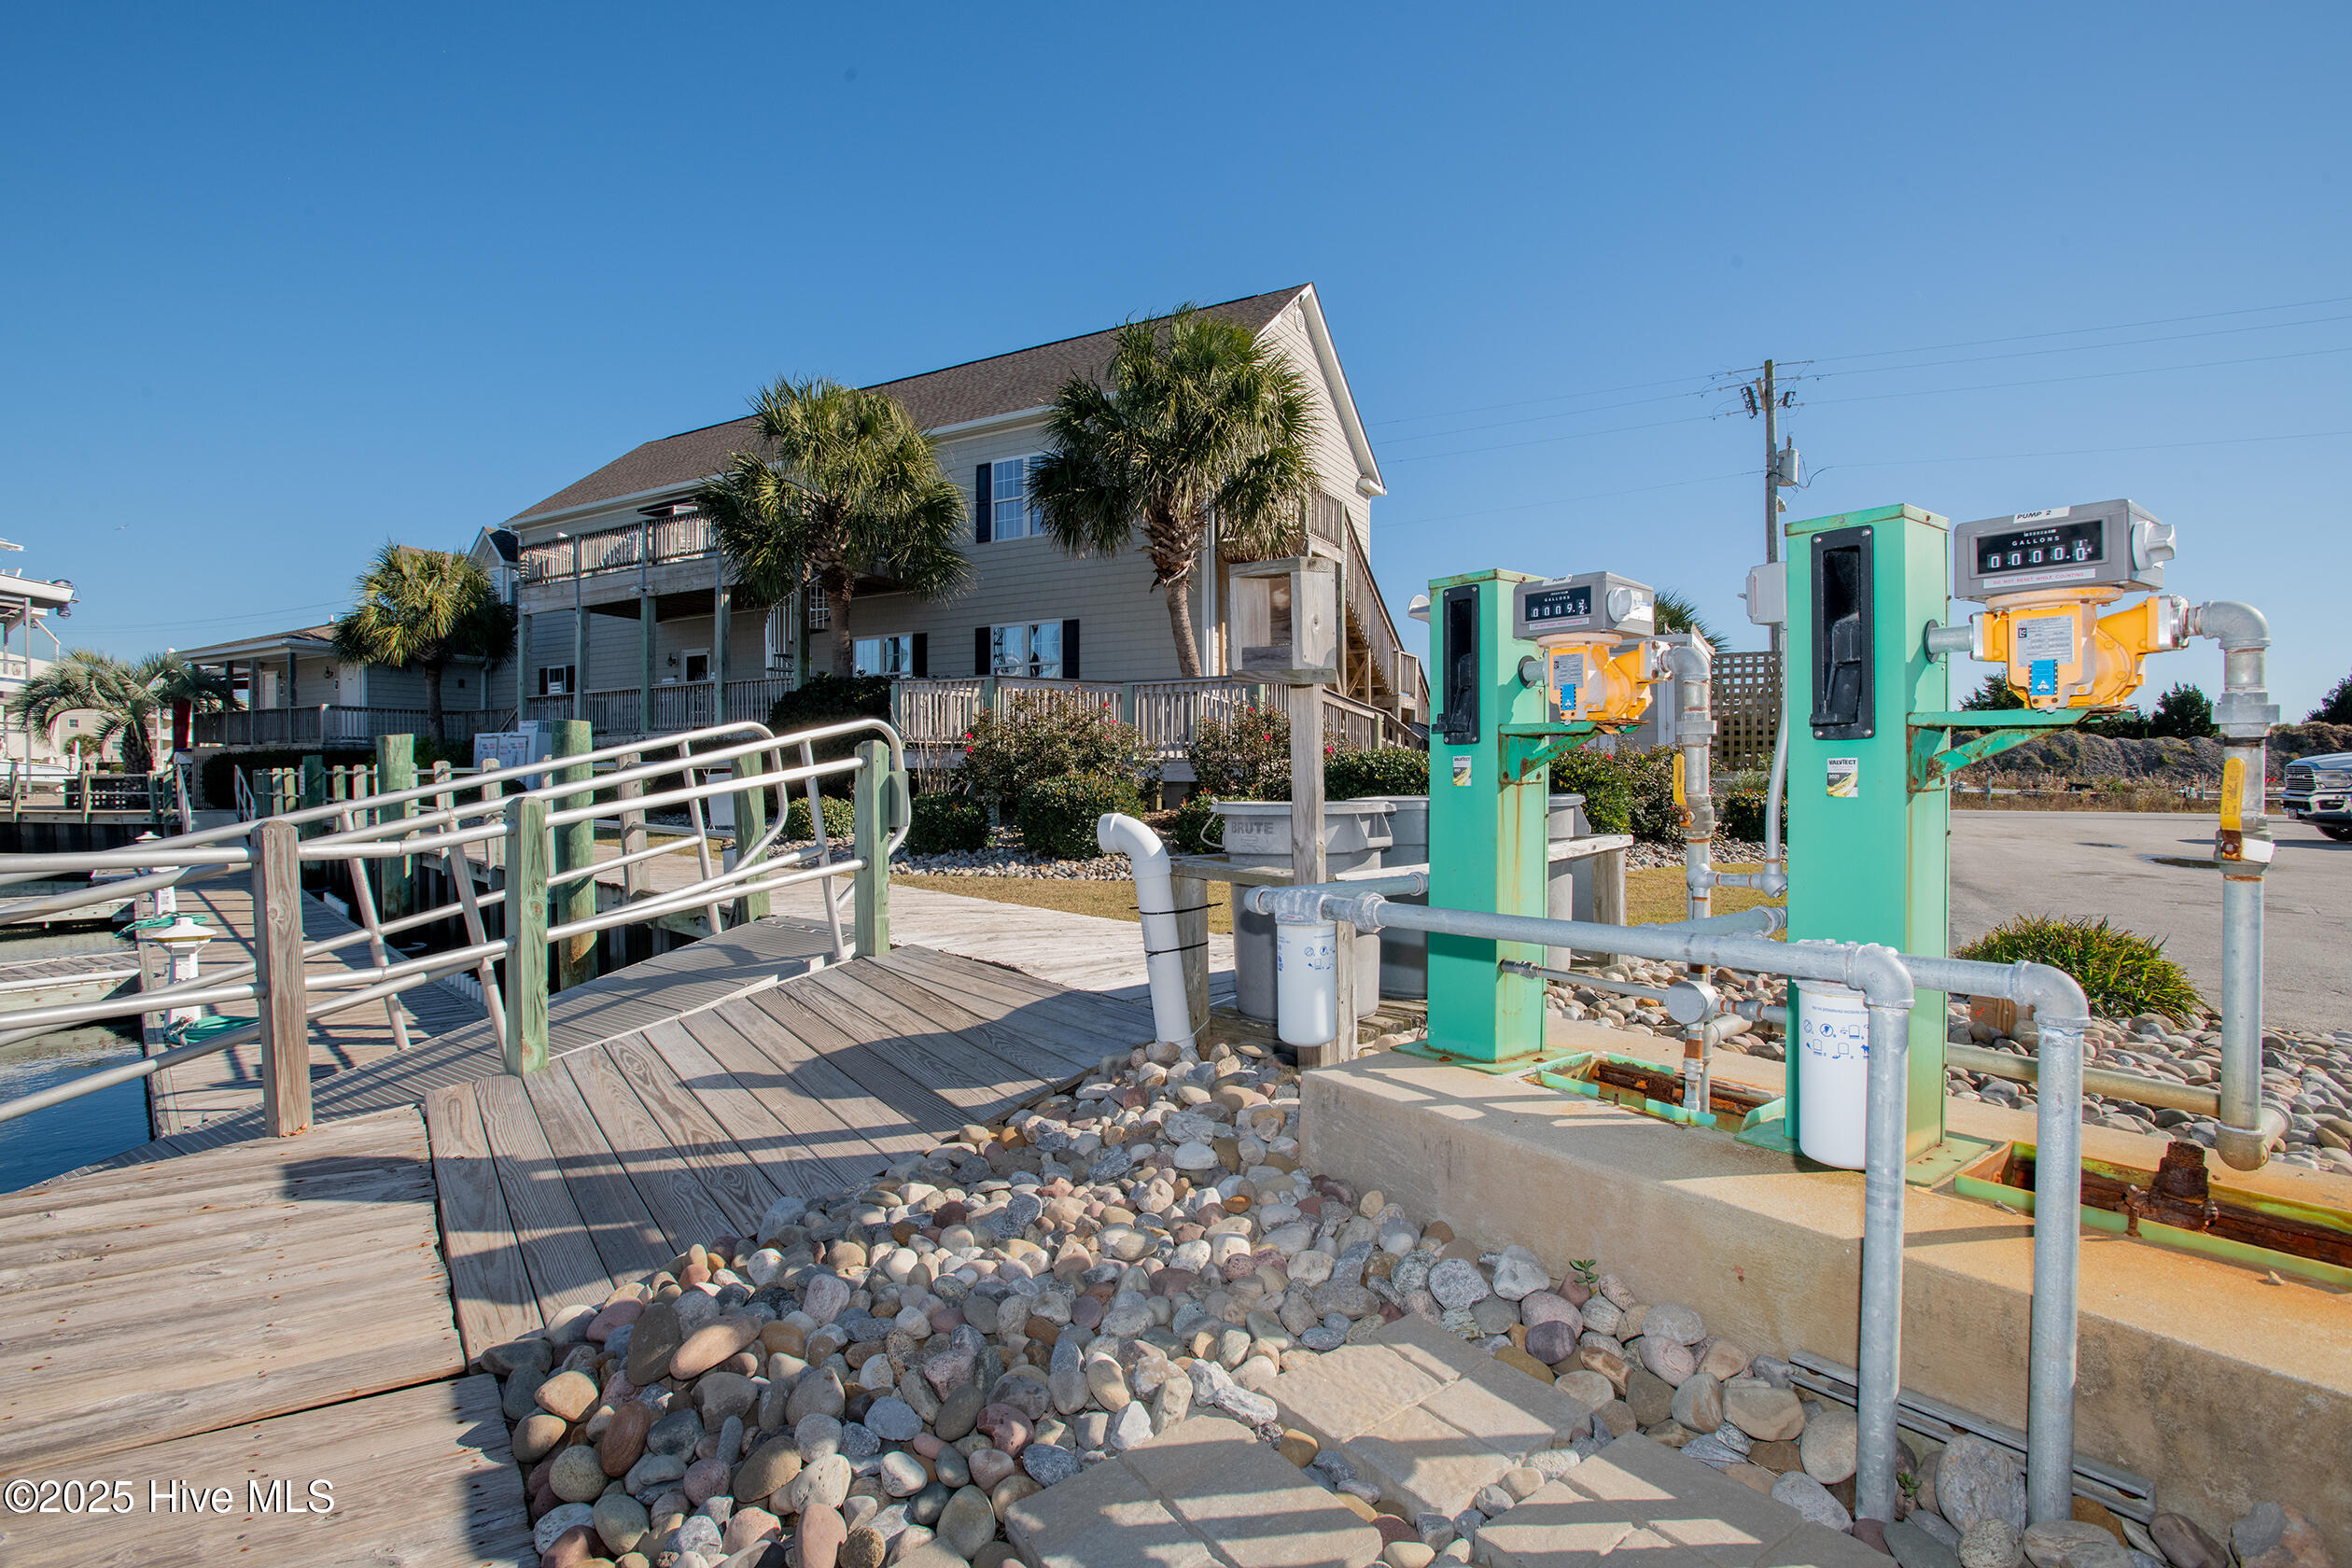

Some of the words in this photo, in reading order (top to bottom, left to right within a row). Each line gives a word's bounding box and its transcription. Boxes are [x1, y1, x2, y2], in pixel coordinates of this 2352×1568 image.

[2017, 511, 2042, 520] PUMP
[2011, 535, 2061, 547] GALLONS
[1544, 595, 1570, 603] GALLONS
[1231, 820, 1274, 834] BRUTE
